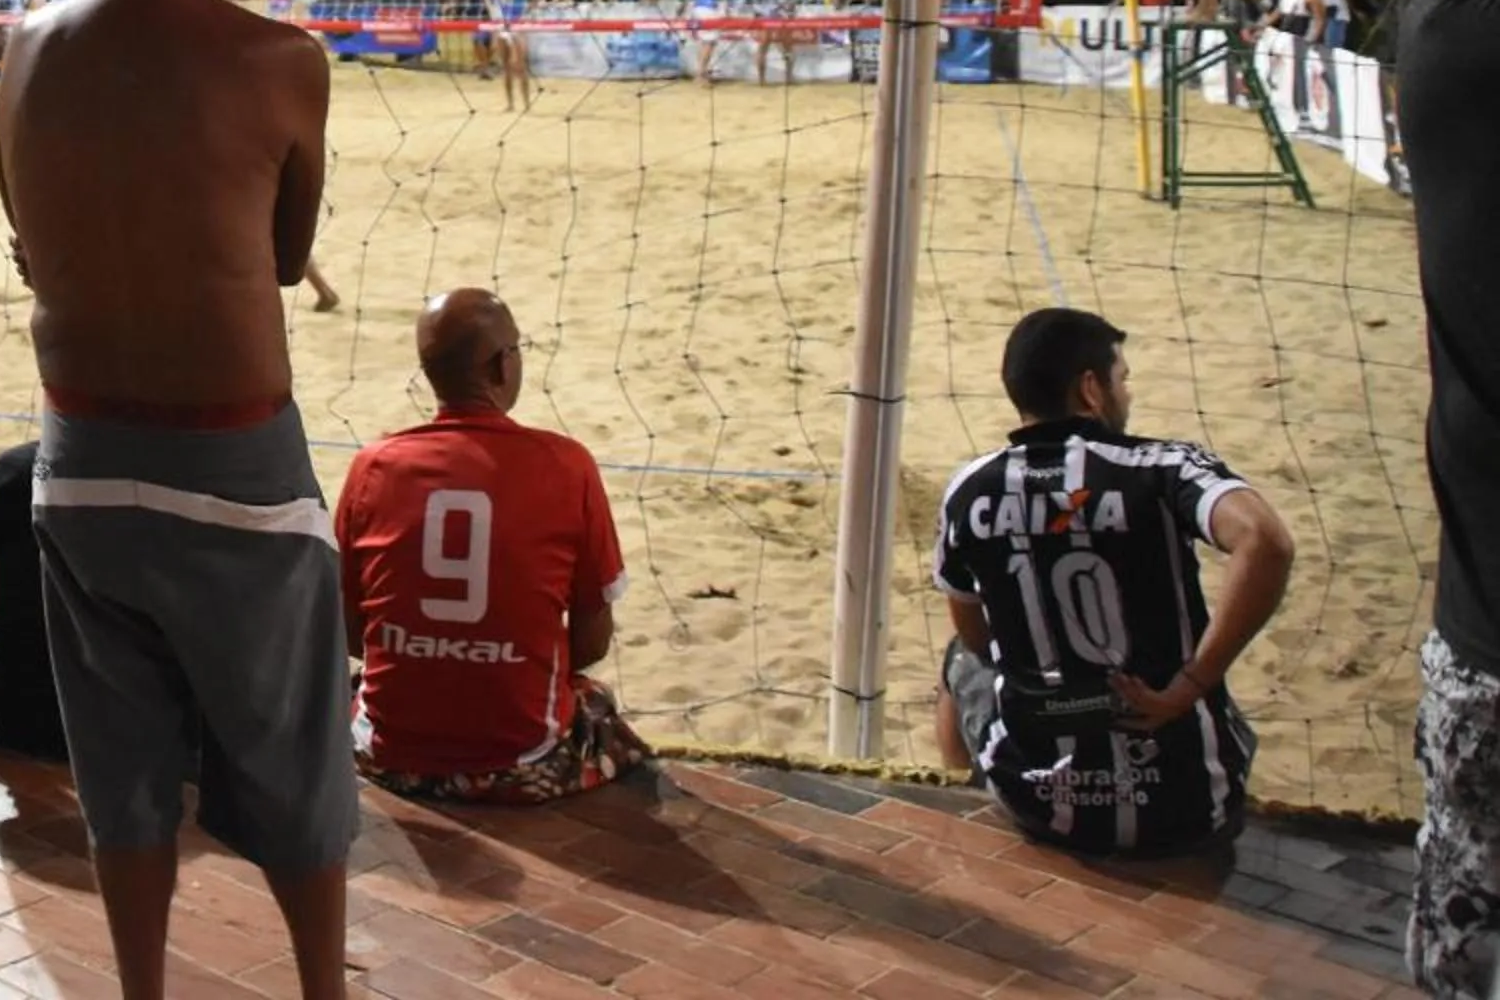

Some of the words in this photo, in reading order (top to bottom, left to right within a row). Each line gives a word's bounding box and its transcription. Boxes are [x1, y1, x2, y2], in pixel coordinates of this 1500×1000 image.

[418, 488, 493, 624] 9
[968, 488, 1130, 540] CAIXA
[1007, 550, 1131, 686] 10
